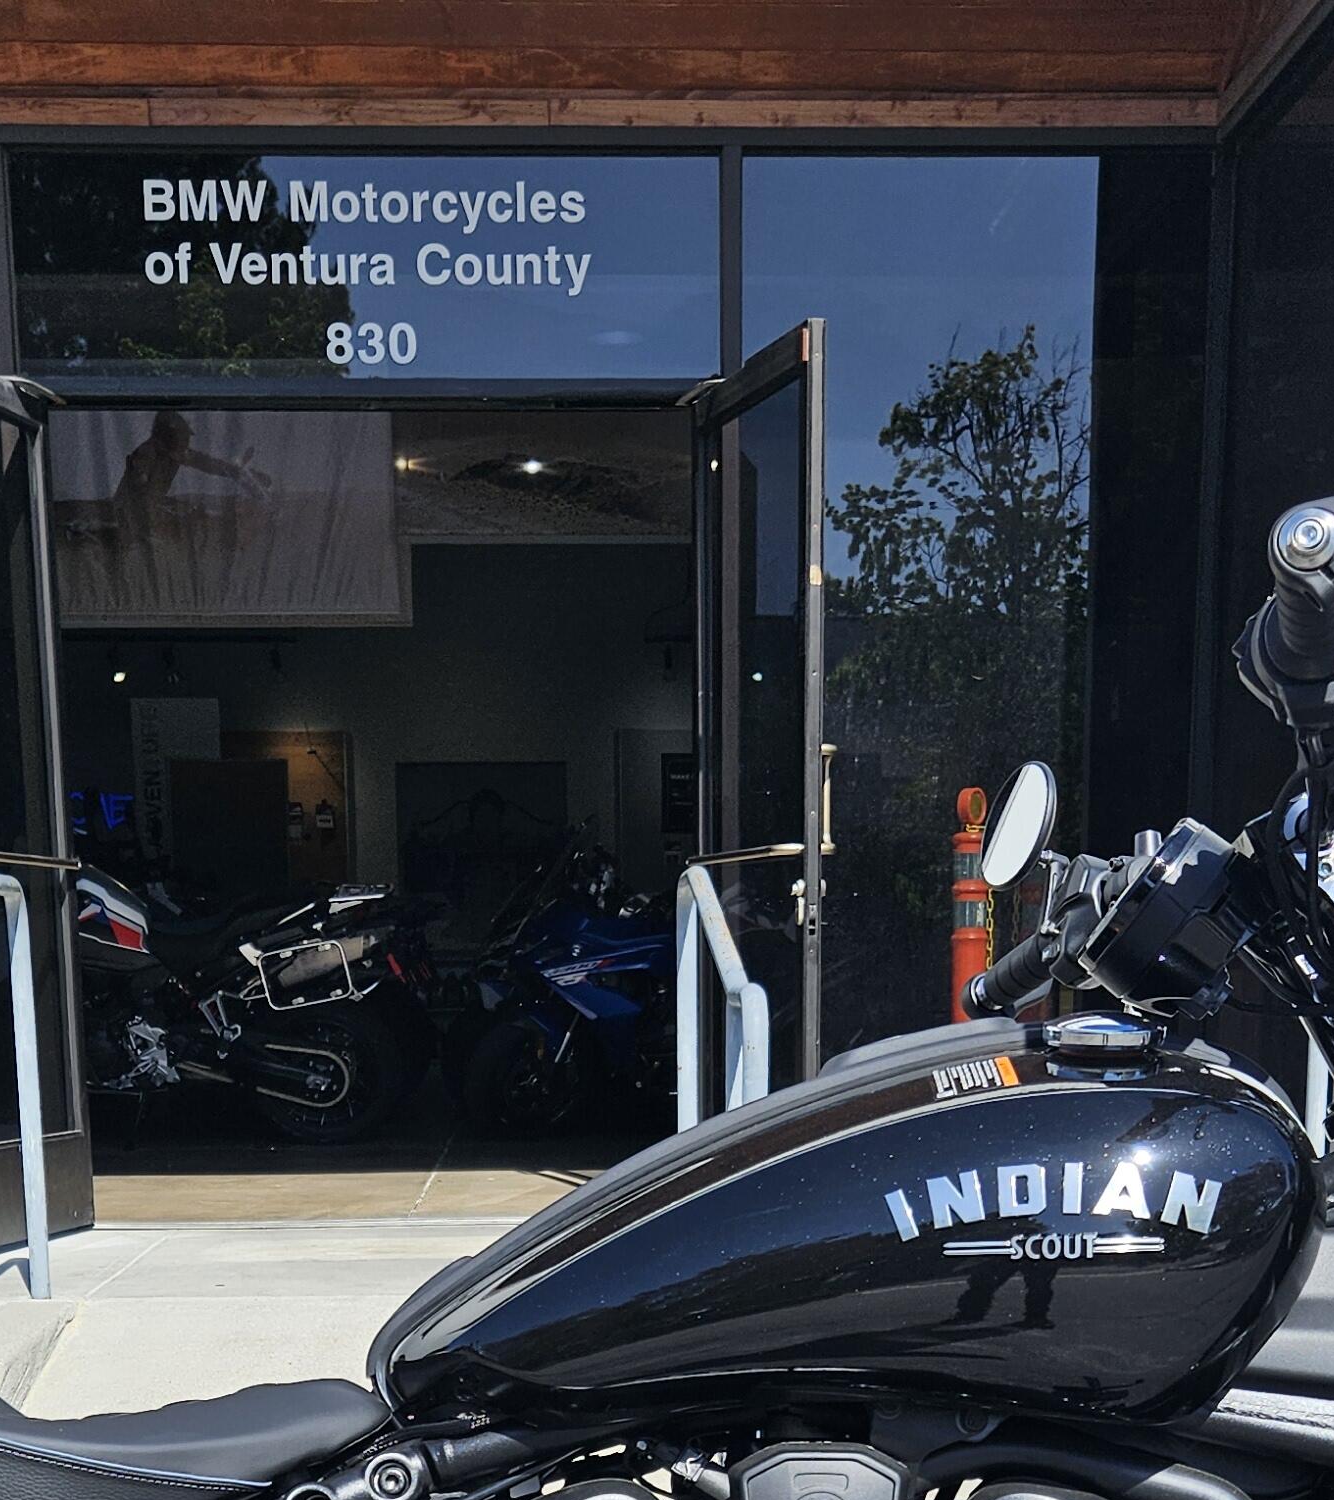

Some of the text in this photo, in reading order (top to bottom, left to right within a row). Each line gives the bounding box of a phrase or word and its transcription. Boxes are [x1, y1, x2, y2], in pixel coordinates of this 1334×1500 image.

[142, 179, 586, 234] BMW Motorcycles
[144, 242, 592, 296] of Ventura County
[326, 322, 417, 365] 830
[884, 1161, 1223, 1243] INDIAN
[1009, 1232, 1098, 1261] SCOUT
